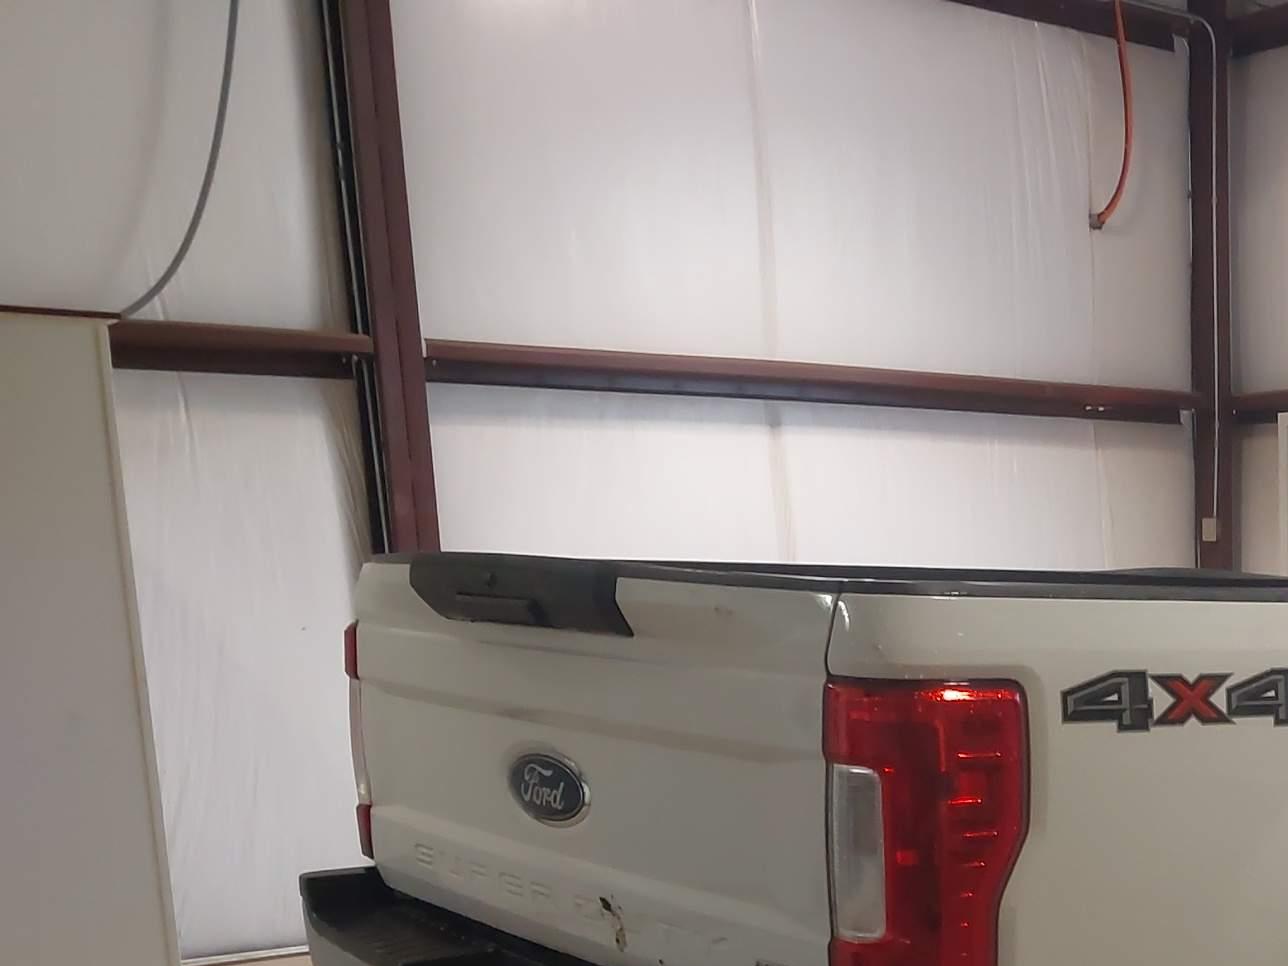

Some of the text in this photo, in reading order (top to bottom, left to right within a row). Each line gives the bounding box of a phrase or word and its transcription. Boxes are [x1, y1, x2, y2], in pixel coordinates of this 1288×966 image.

[520, 763, 565, 810] Ford
[412, 841, 731, 954] SUPER DTY
